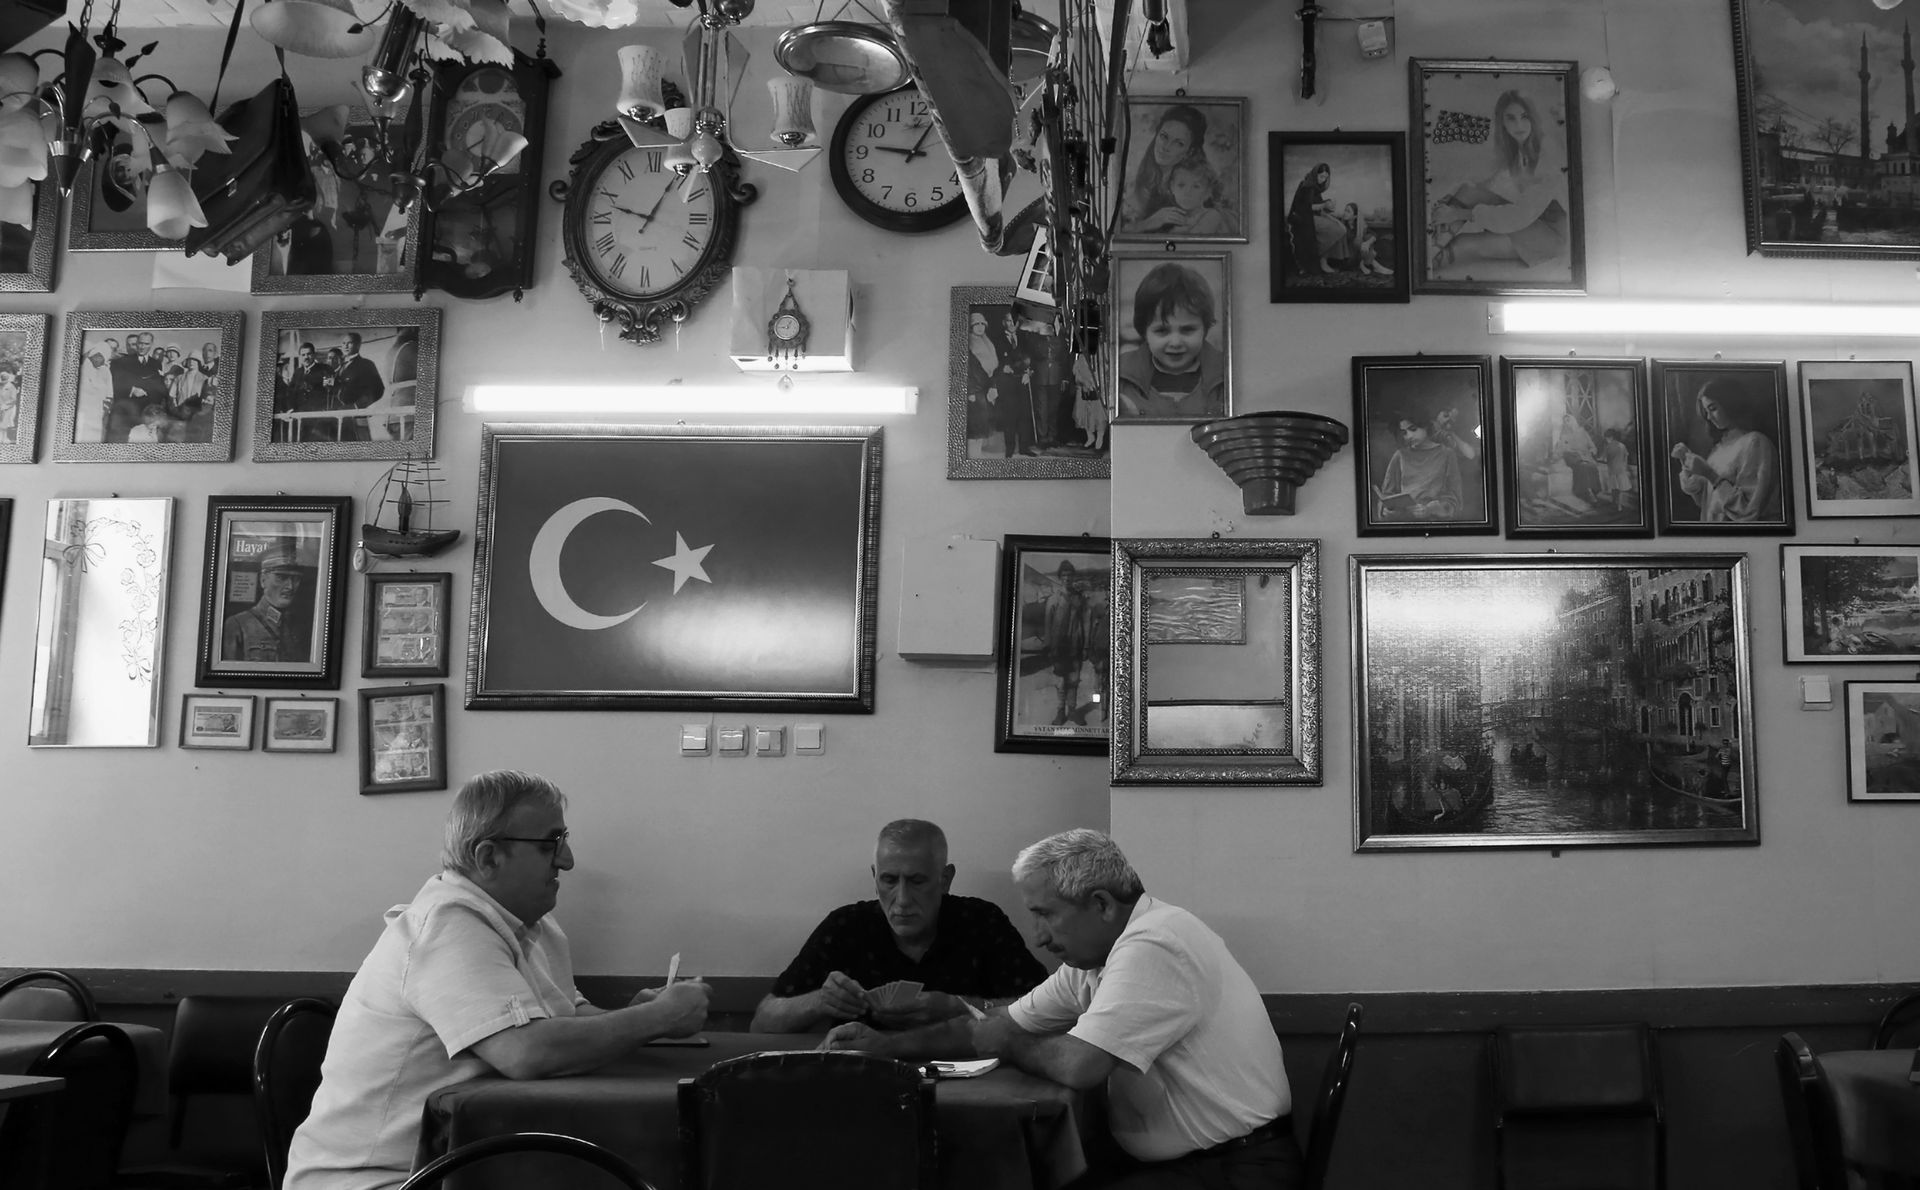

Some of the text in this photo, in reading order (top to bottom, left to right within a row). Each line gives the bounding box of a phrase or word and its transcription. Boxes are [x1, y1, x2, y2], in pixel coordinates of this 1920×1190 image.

[887, 108, 901, 122] 11
[910, 101, 928, 116] 12
[867, 123, 886, 138] 10
[856, 144, 869, 160] 9
[644, 151, 662, 173] XII
[617, 159, 635, 185] XI
[862, 168, 875, 184] 8
[948, 170, 960, 186] 4
[599, 186, 619, 206] X
[881, 185, 893, 200] 7
[904, 192, 917, 208] 6
[930, 186, 944, 202] 5
[593, 209, 613, 225] IX
[689, 213, 708, 225] III
[640, 265, 651, 289] VI
